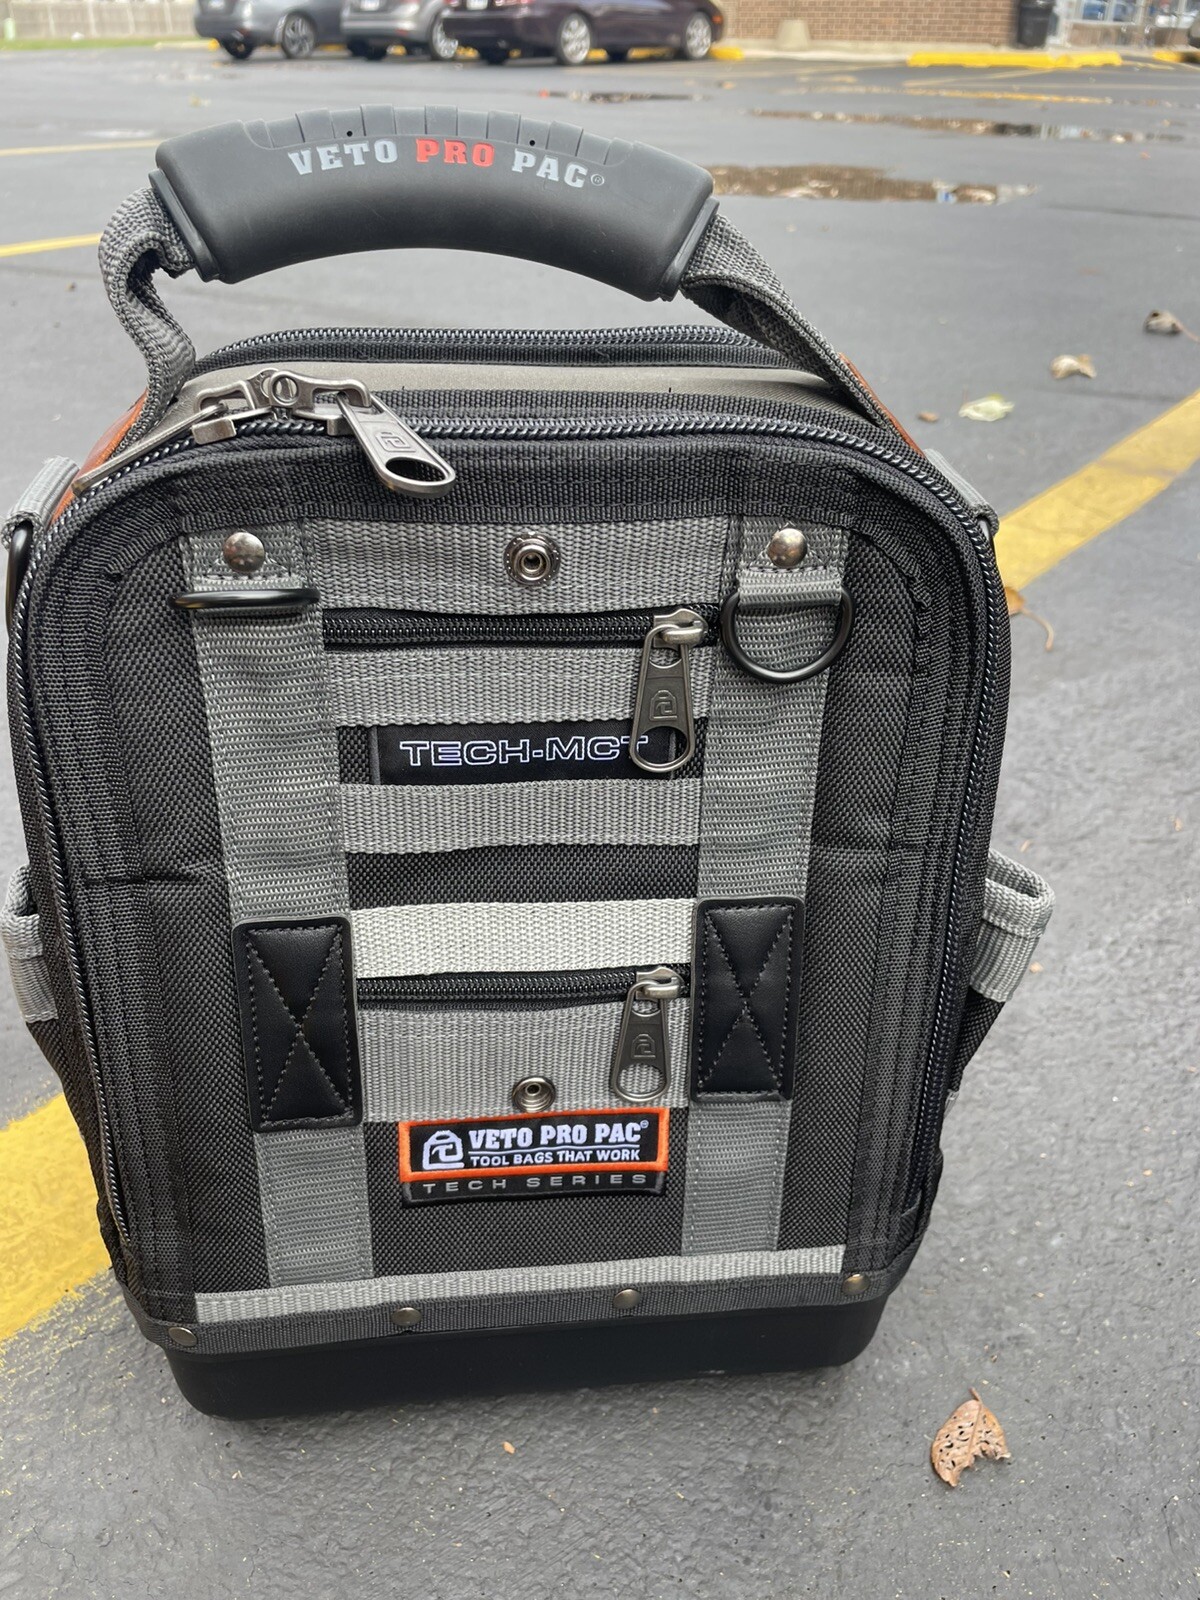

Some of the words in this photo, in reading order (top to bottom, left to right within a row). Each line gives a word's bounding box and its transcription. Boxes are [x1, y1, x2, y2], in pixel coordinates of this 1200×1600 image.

[288, 139, 398, 175] VETO
[415, 138, 495, 167] PRO
[468, 1127, 533, 1150] VETO
[540, 1123, 588, 1145] PRO
[470, 1155, 509, 1167] TOOL
[513, 1151, 554, 1164] BAGS
[556, 1150, 592, 1163] THAT
[596, 1148, 641, 1162] WORK
[423, 1179, 507, 1194] TECH
[526, 1174, 647, 1188] SERIES
